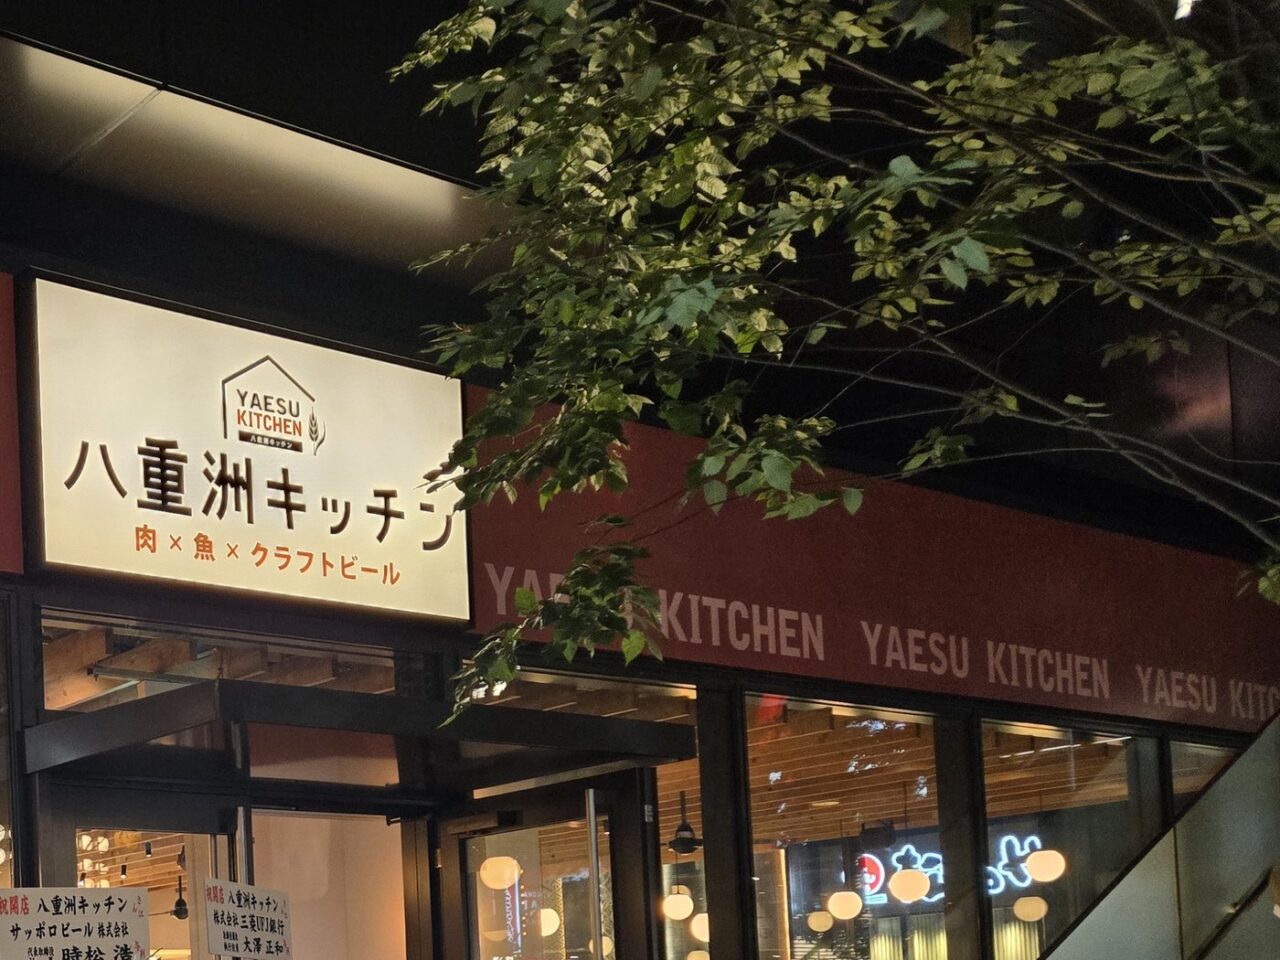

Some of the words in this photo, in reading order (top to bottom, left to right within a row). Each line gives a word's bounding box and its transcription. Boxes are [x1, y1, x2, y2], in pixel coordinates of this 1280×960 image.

[236, 388, 300, 418] YAESU
[236, 408, 302, 437] KITCHEN
[63, 436, 454, 551] 八重洲キッチン
[657, 588, 825, 661] KITCHEN
[860, 620, 969, 679] YAESU
[986, 640, 1110, 700] KITCHEN
[1136, 664, 1217, 713] YAESU
[37, 895, 128, 916] 八重洲キッチン
[228, 889, 279, 912] 八重洲キッチン
[10, 920, 94, 941] サッポロビール
[97, 921, 129, 938] 株式会社
